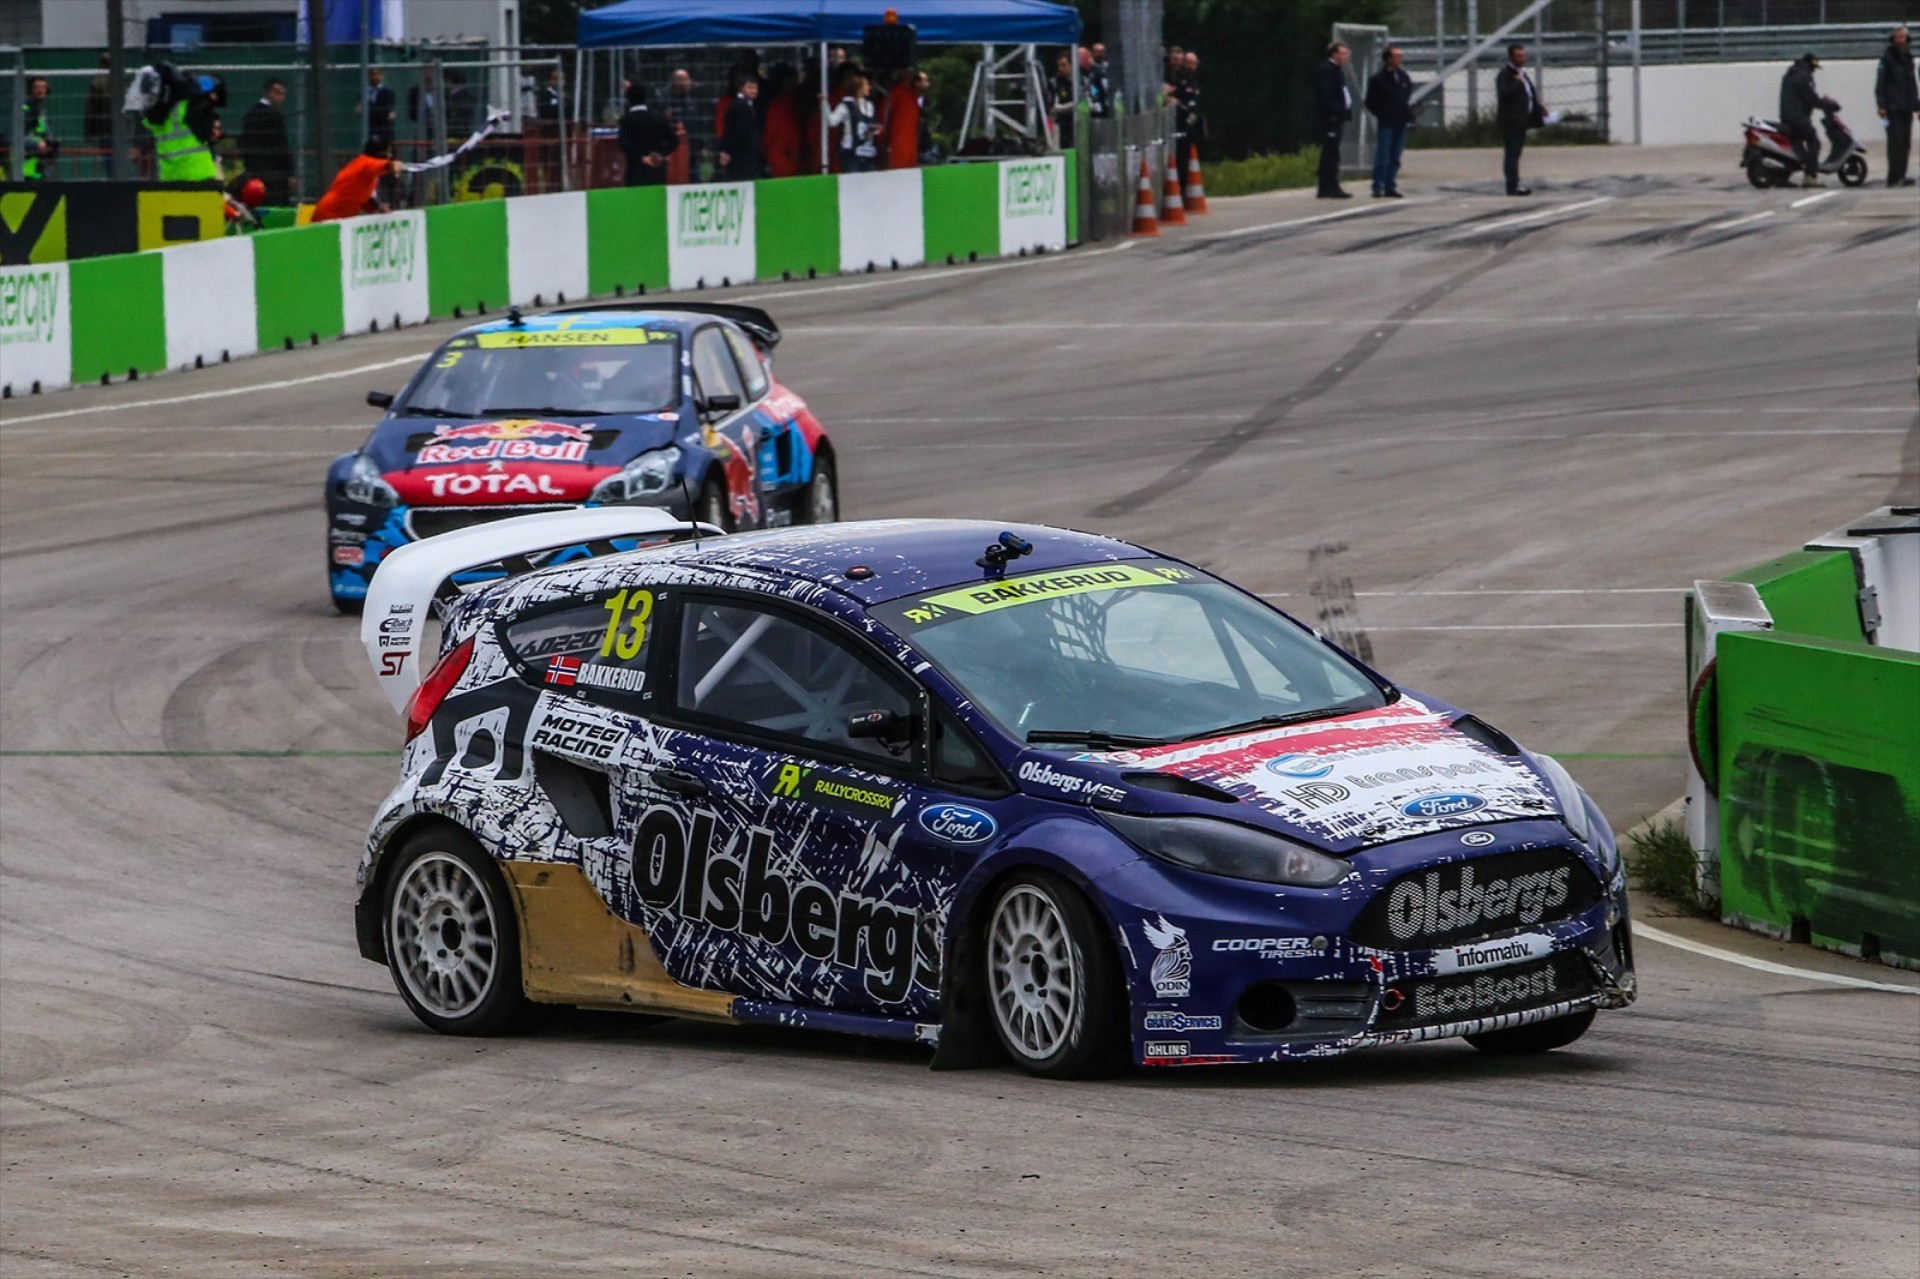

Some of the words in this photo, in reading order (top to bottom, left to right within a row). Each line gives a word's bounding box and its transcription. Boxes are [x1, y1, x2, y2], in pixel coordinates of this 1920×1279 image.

[506, 332, 609, 345] HANSEN
[436, 352, 463, 368] 3
[416, 440, 502, 464] Red
[501, 440, 589, 461] Bull
[424, 473, 565, 497] TOTAL
[969, 570, 1132, 605] BAKKERUD
[601, 589, 653, 660] 13
[379, 651, 413, 676] ST
[576, 663, 647, 692] BAKKERUD
[541, 714, 625, 744] MOTEGI
[532, 729, 614, 759] RACING
[1018, 761, 1085, 793] Olsbergs
[1082, 781, 1128, 803] MSE
[1344, 759, 1501, 789] transport
[814, 780, 894, 809] RALLYCROSSRX
[1418, 796, 1474, 816] Ford
[932, 806, 983, 840] Ford
[631, 804, 941, 1003] Olsbergs
[1387, 865, 1571, 940] Olsbergs
[1212, 937, 1310, 951] COOPER
[1259, 949, 1307, 959] TIRES
[1156, 980, 1189, 992] ODIN
[1415, 964, 1557, 1018] EcoBoost
[1147, 1042, 1188, 1056] ÖHLINS
